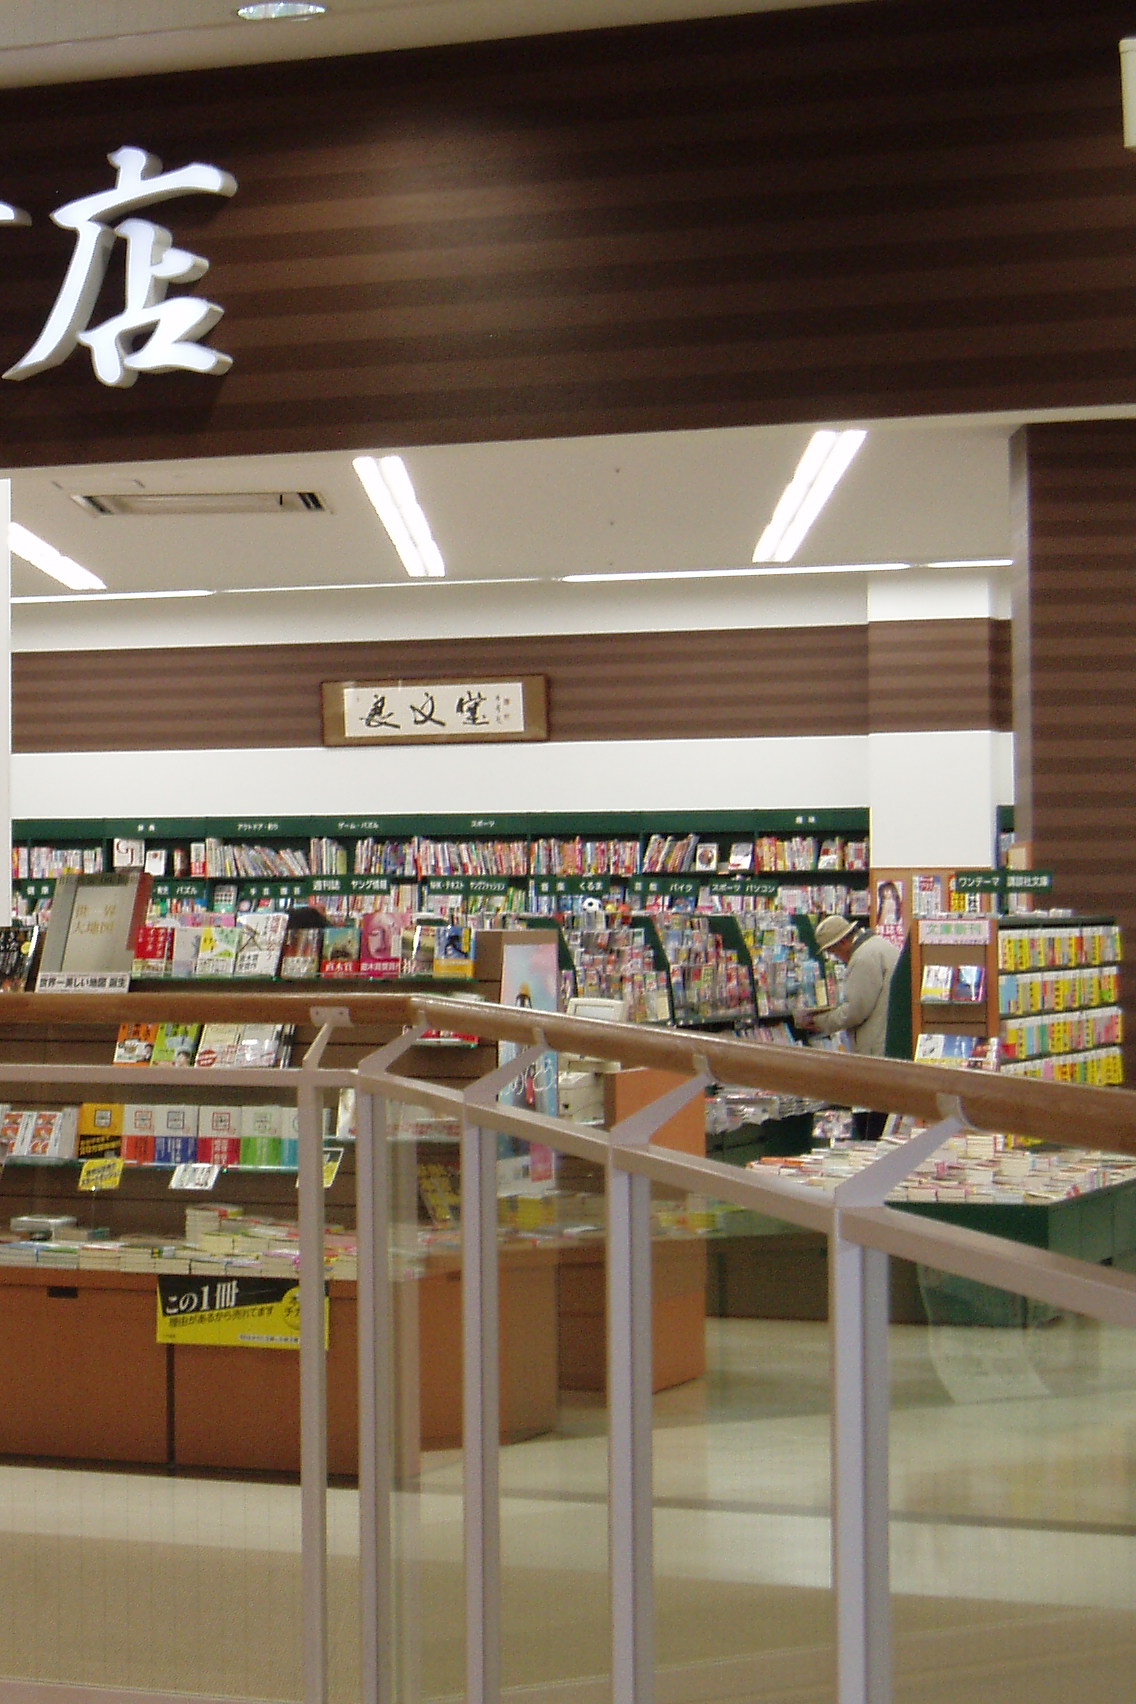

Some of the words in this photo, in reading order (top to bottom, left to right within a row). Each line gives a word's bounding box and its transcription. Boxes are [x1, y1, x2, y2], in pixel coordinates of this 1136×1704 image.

[359, 690, 490, 729] 良文堂
[958, 876, 1000, 887] ワンテーマ
[670, 883, 693, 893] バイク
[711, 882, 742, 892] スポーツ
[745, 883, 777, 894] パソコン
[165, 1279, 240, 1315] この1冊
